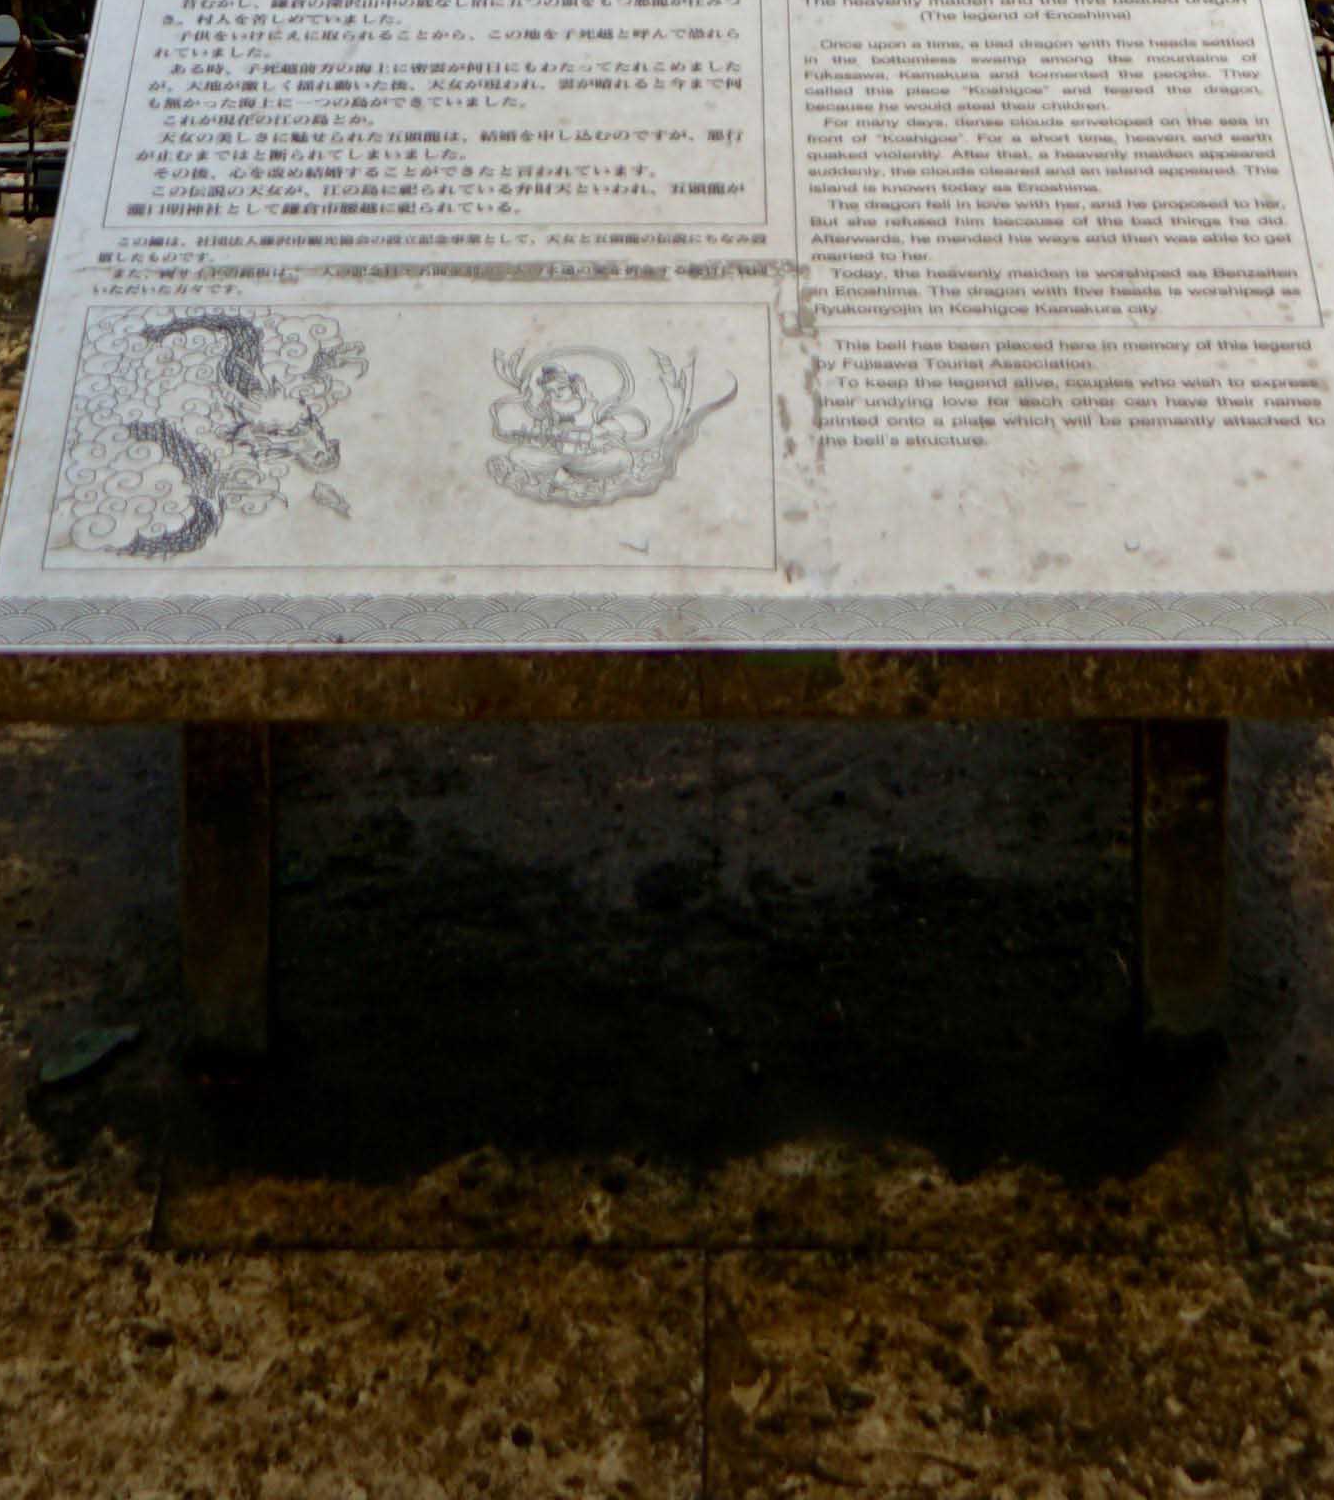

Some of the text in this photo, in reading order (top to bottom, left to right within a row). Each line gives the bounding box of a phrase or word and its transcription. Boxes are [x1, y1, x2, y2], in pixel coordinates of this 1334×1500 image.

[919, 9, 1132, 23] (The legend Enoshima)
[835, 339, 1312, 353] This bell has been placed here memory this legend
[842, 358, 985, 371] Fujisawa Tourist
[865, 377, 1222, 391] keep the legend couples who wish
[820, 396, 1322, 409] their undying love for each other can have their names
[886, 415, 1302, 429] onto plate which will attached
[818, 435, 901, 447] the bell's
